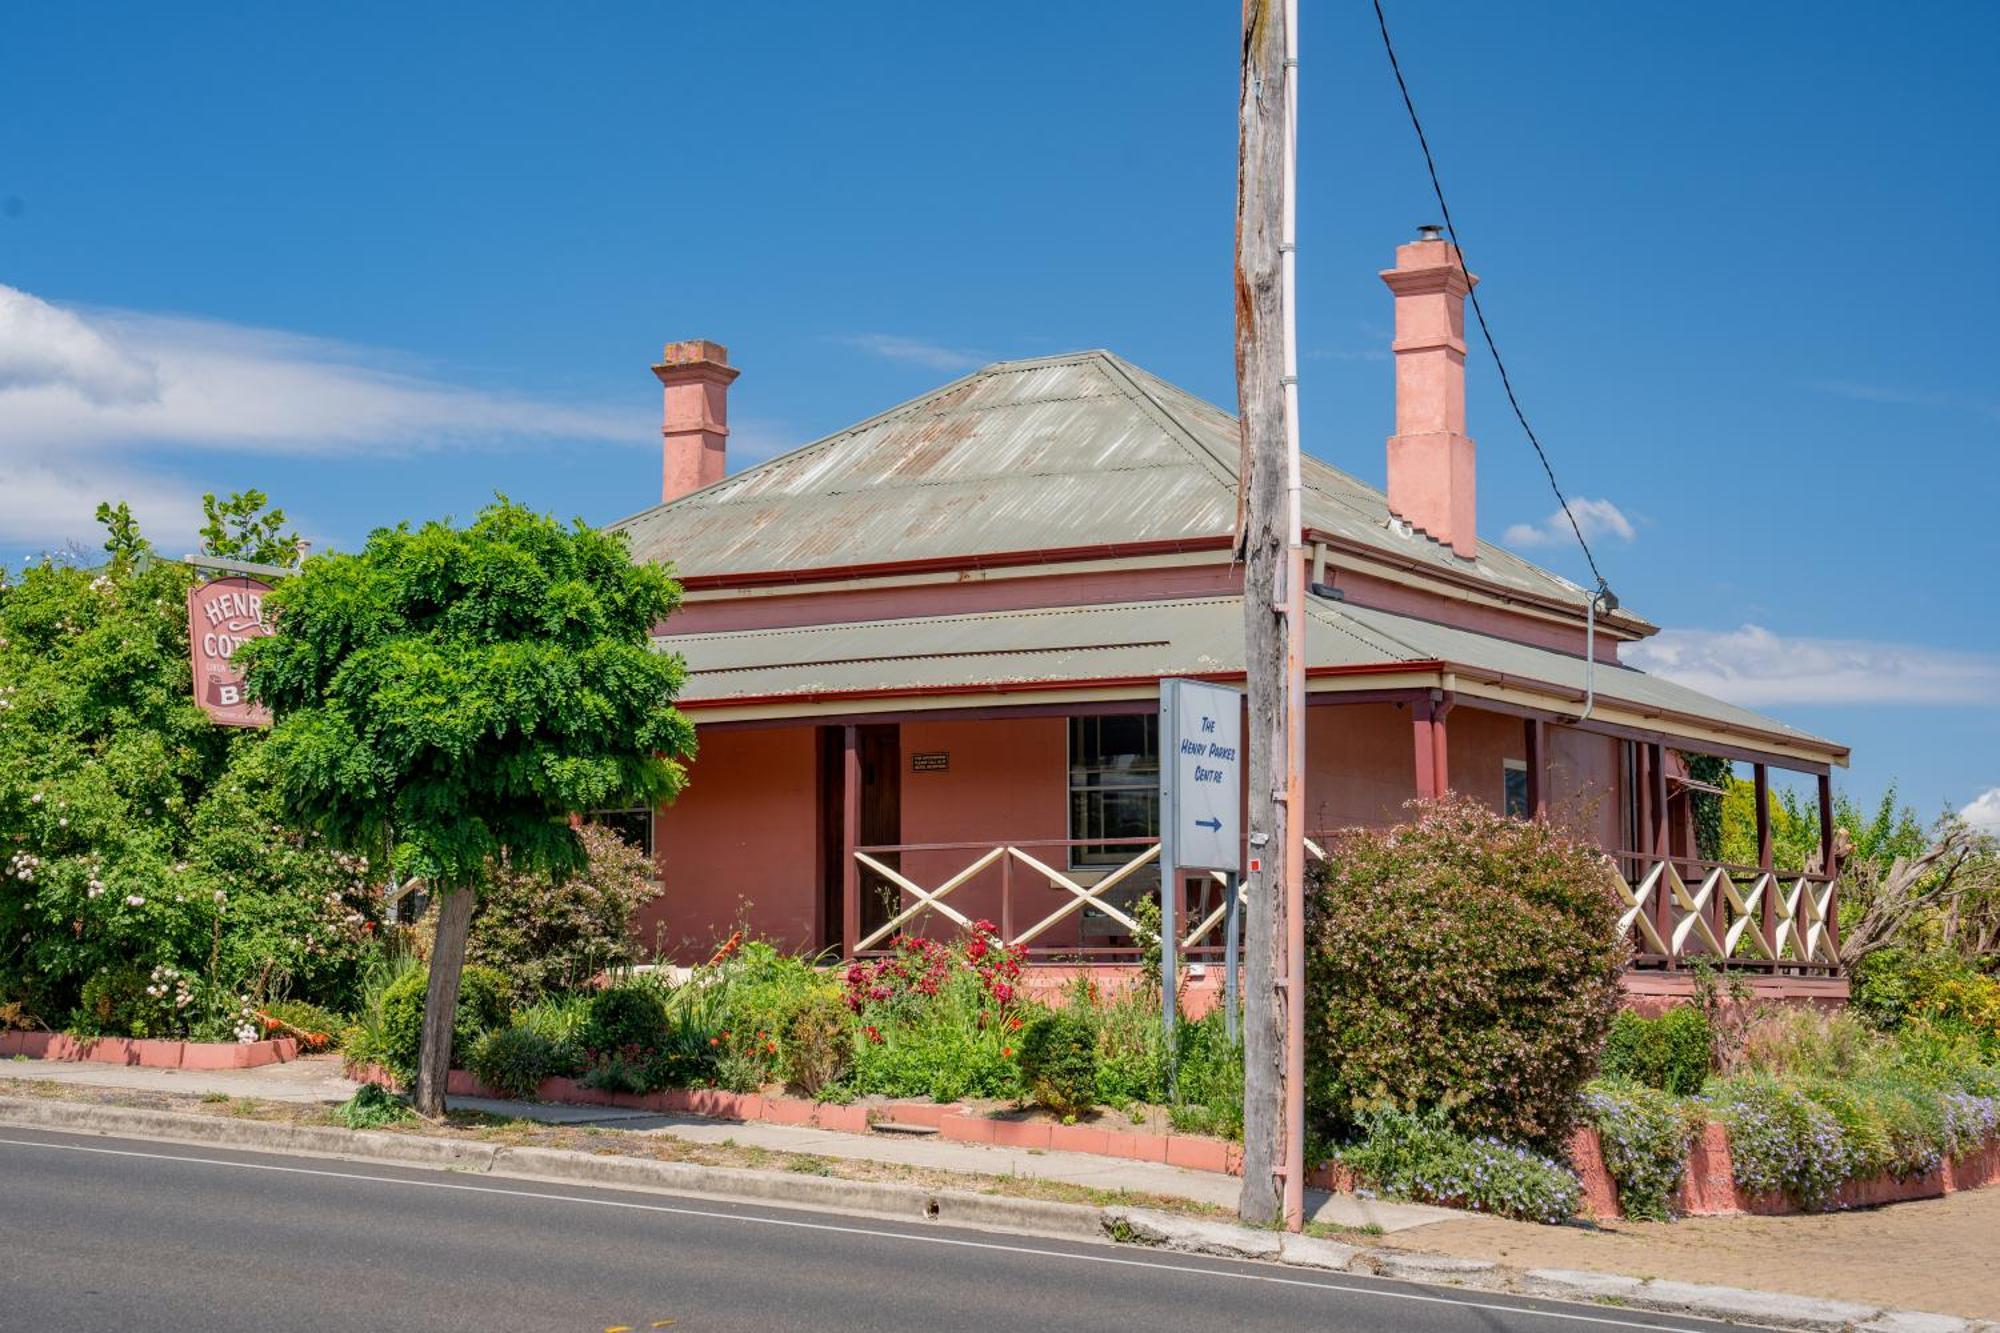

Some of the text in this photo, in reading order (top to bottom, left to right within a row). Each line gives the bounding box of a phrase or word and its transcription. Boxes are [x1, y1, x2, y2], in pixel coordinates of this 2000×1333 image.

[203, 592, 265, 630] HENR
[1201, 717, 1215, 733] THE
[1181, 738, 1236, 762] HENRY PARKES
[1194, 766, 1223, 784] CENTRE
